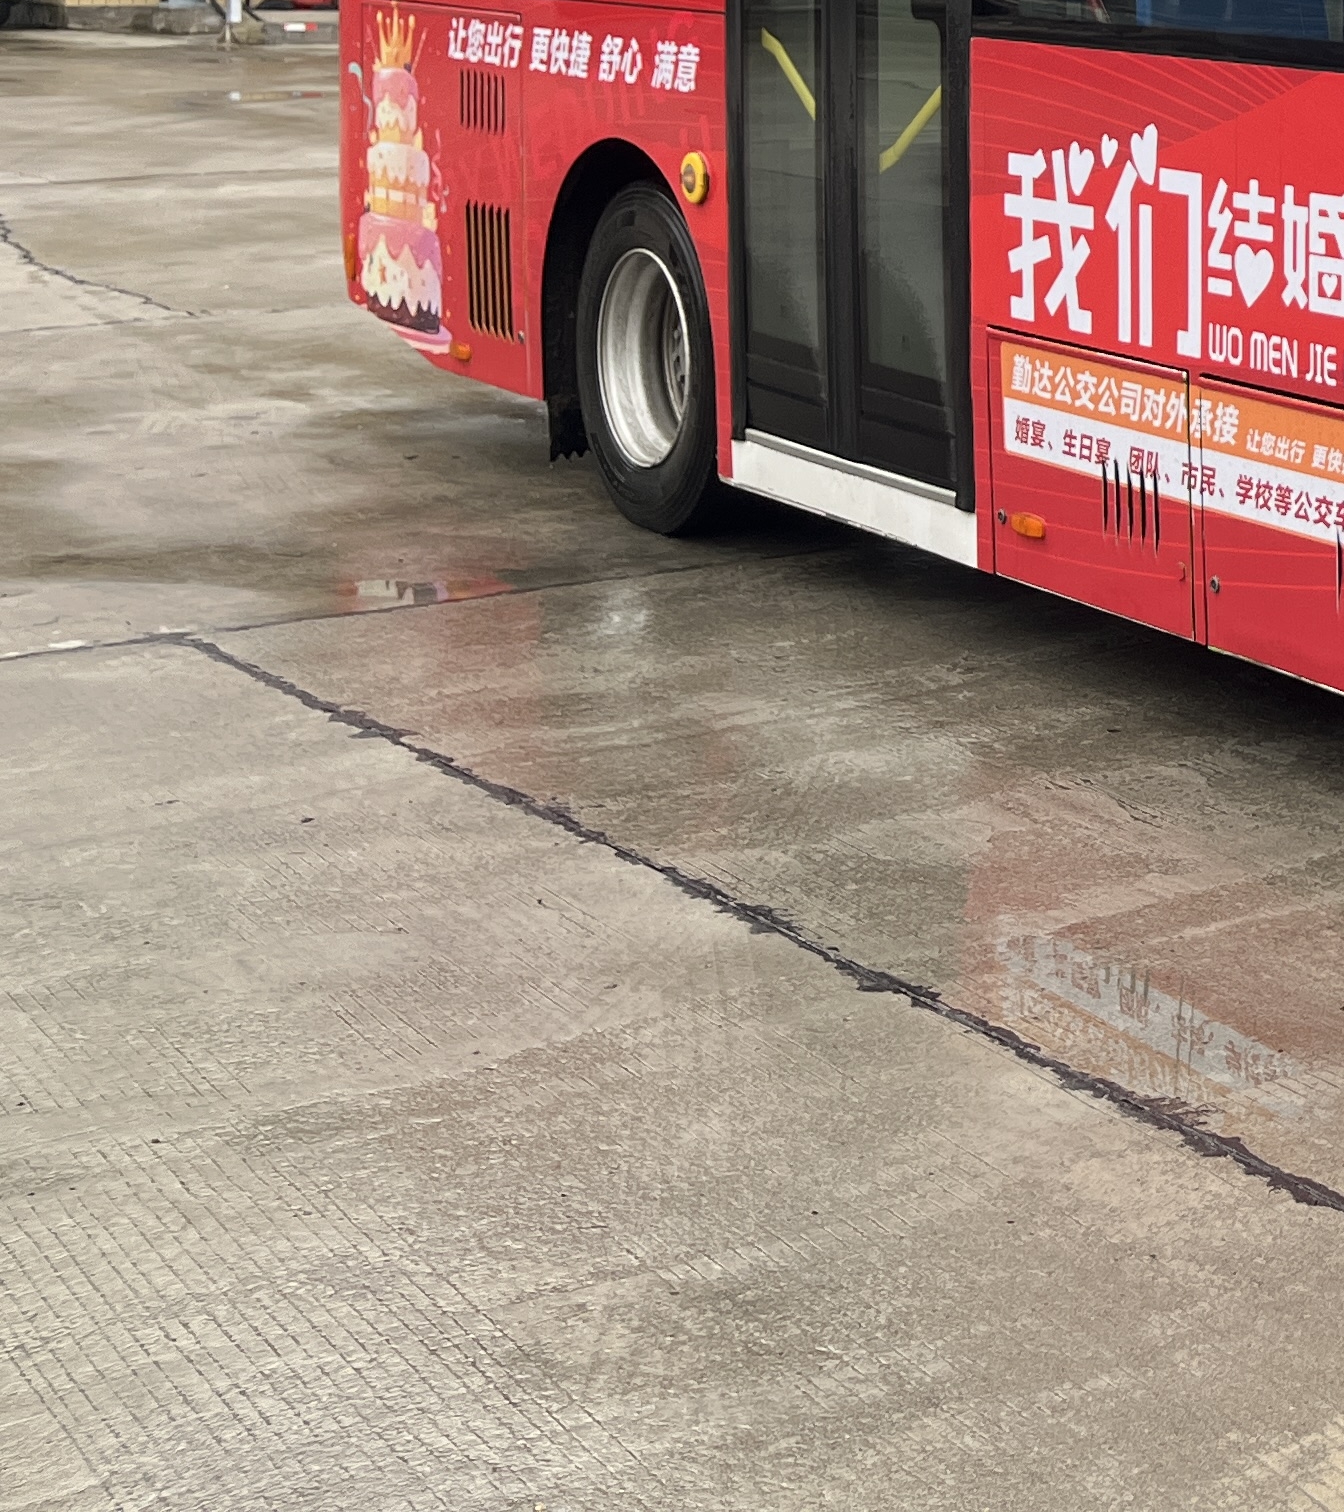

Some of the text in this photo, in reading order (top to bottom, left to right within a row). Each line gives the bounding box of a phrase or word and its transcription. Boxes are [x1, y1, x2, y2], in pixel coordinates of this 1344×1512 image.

[447, 17, 700, 92] 让您出行 更快捷 舒心 满意
[1208, 322, 1243, 363] WO
[1250, 330, 1298, 380] MEN
[1305, 338, 1337, 388] JIE
[1010, 353, 1241, 447] 勤达公交公司对外承接
[1246, 428, 1307, 464] 让您出行
